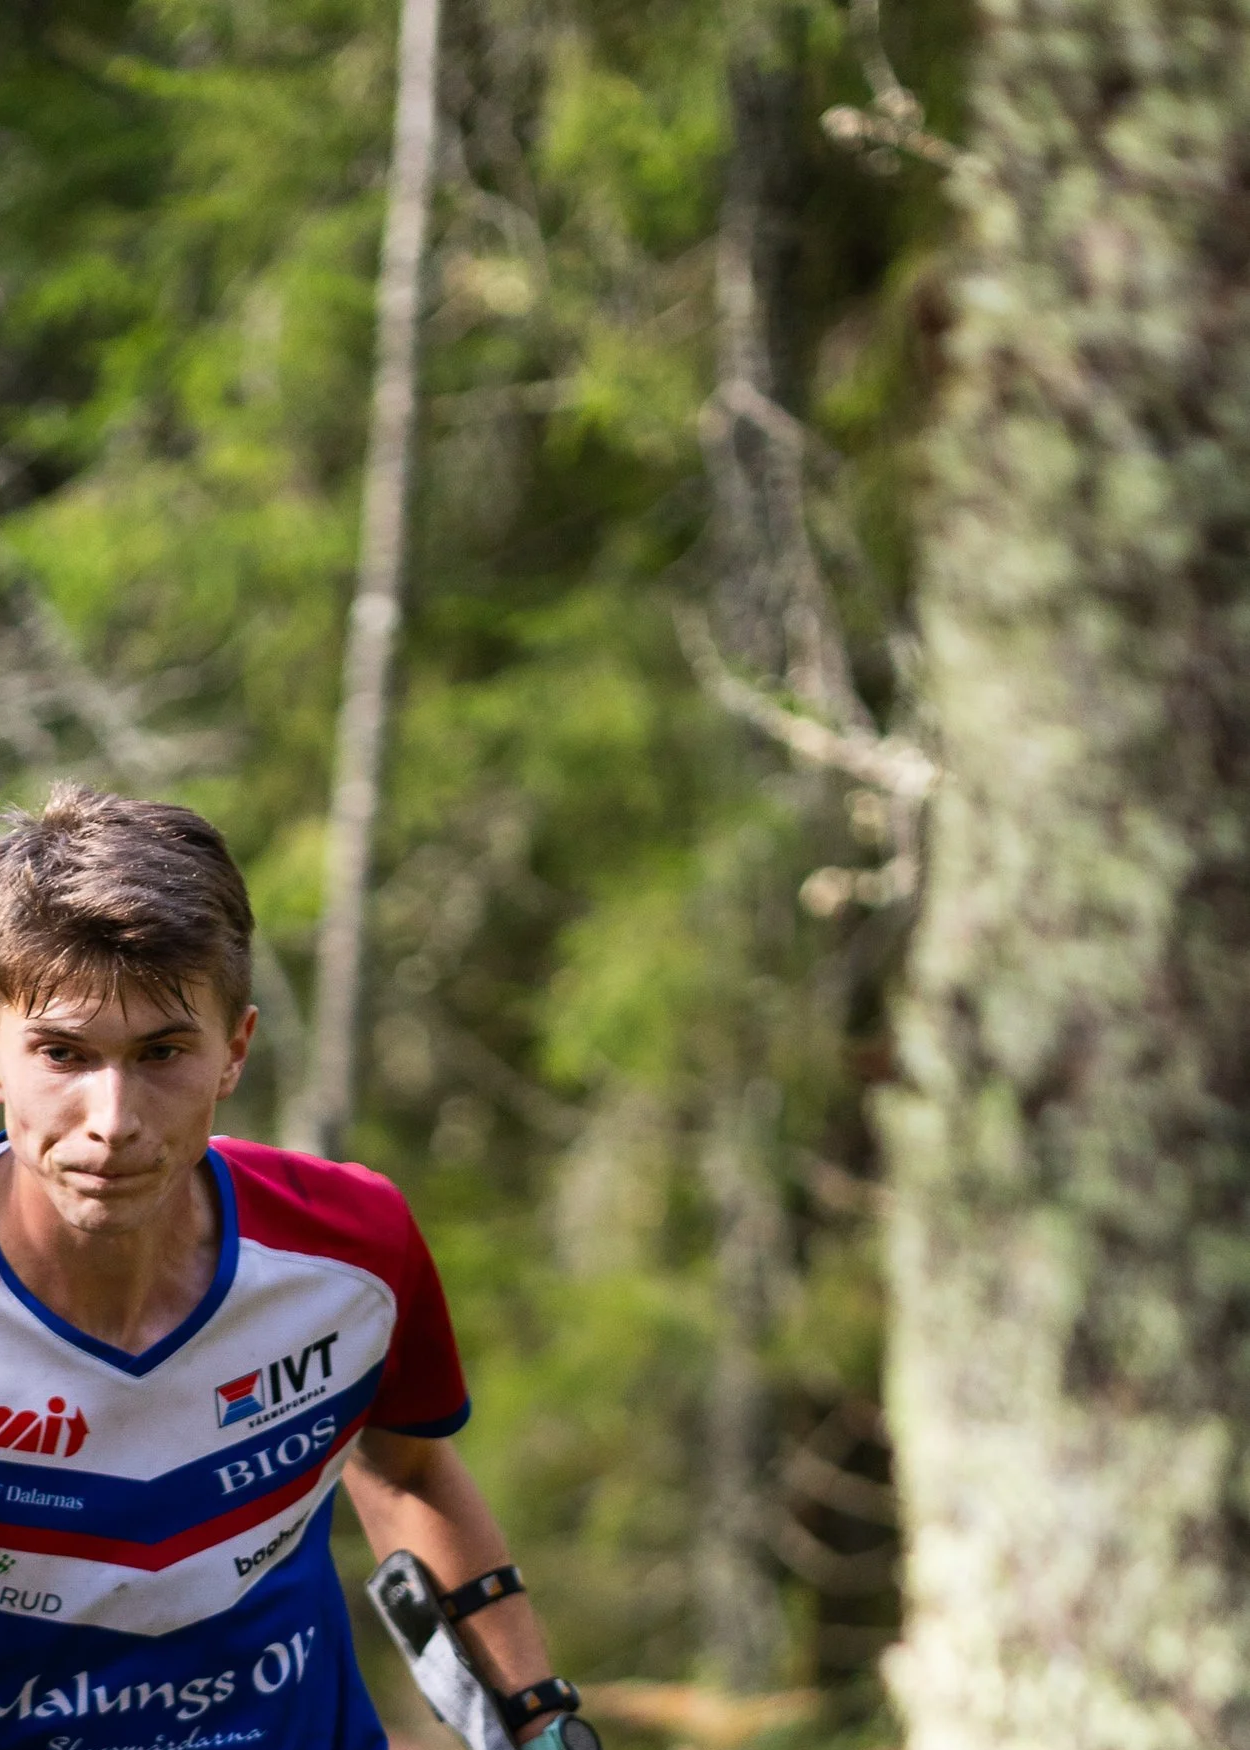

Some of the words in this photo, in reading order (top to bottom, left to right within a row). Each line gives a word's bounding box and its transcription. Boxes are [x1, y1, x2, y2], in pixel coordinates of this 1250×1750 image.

[269, 1331, 339, 1405] IVT
[213, 1414, 337, 1496] BIOS
[6, 1485, 84, 1510] Dalarnas
